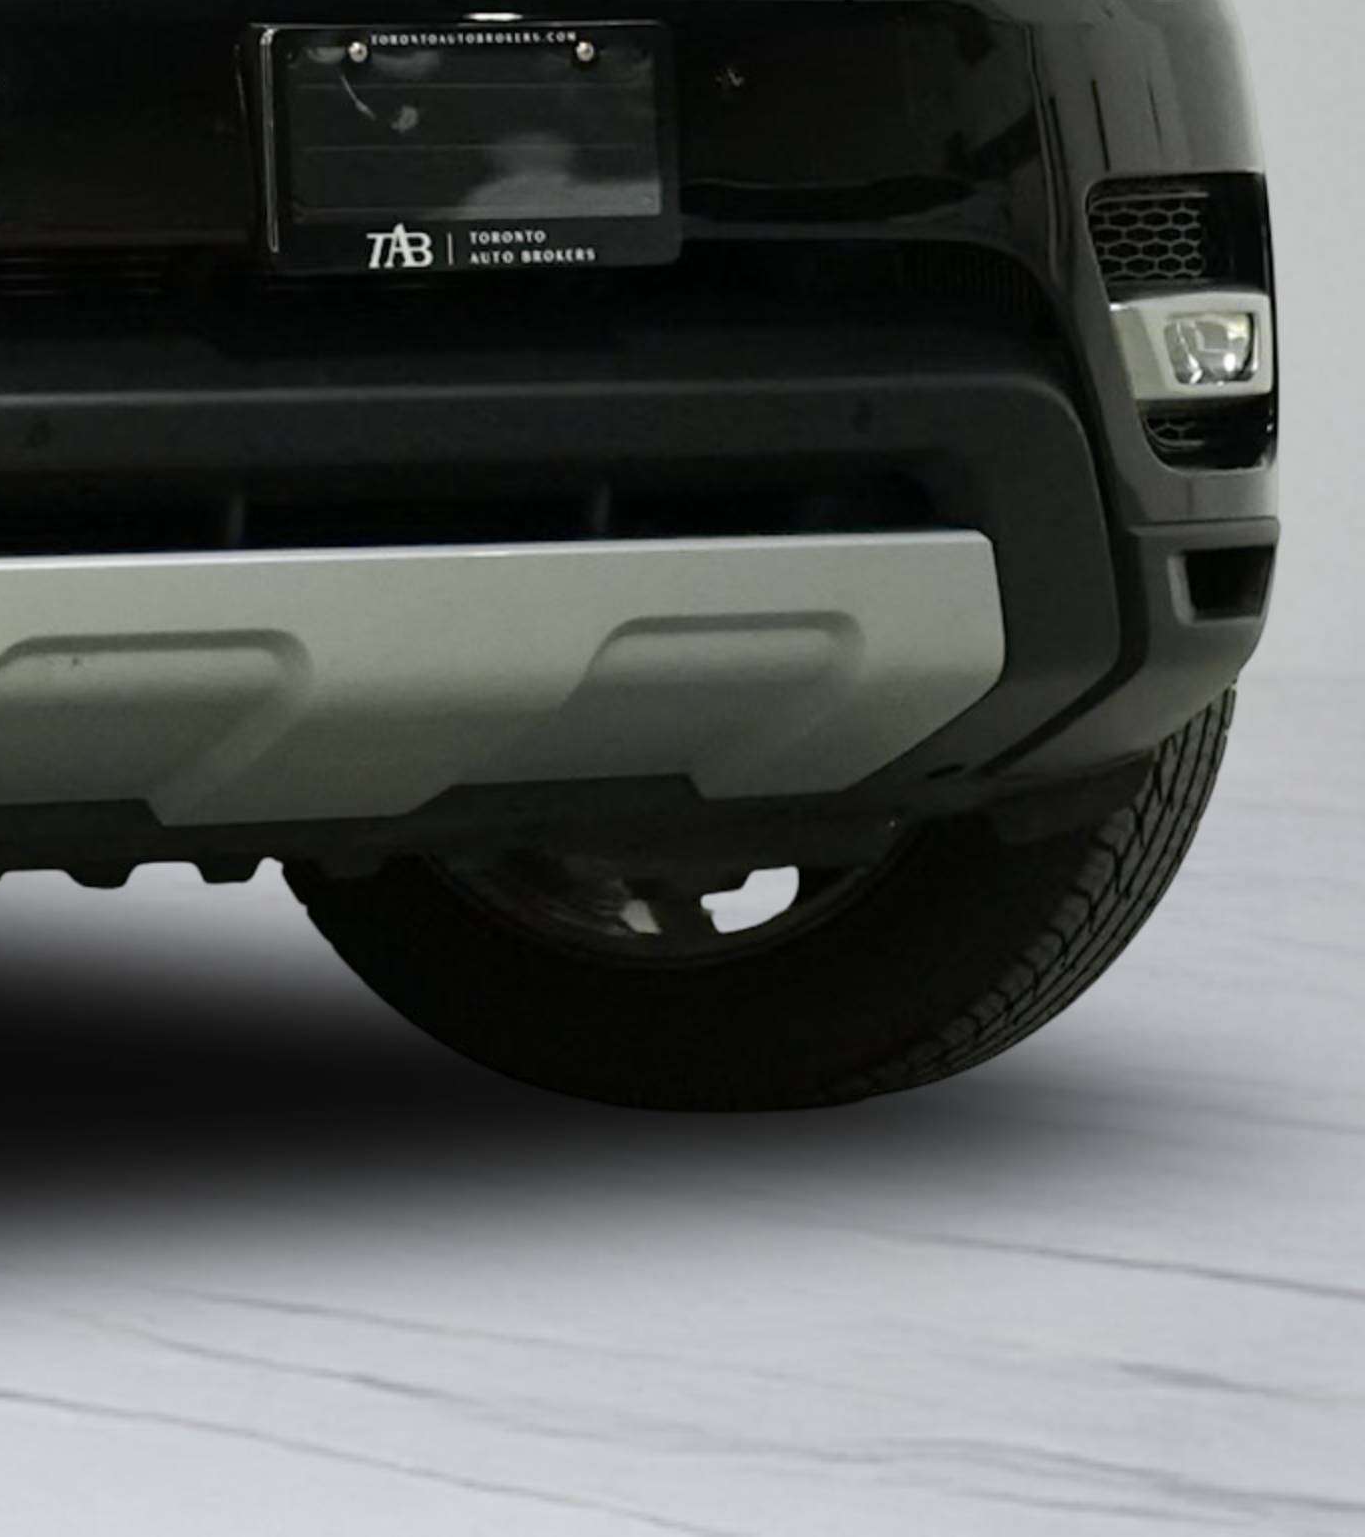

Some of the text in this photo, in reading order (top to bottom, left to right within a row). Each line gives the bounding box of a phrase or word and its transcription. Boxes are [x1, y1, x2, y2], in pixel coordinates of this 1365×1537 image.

[366, 223, 434, 269] TAB
[470, 230, 547, 245] TORONTO
[470, 248, 597, 265] AUTO BROKERS
